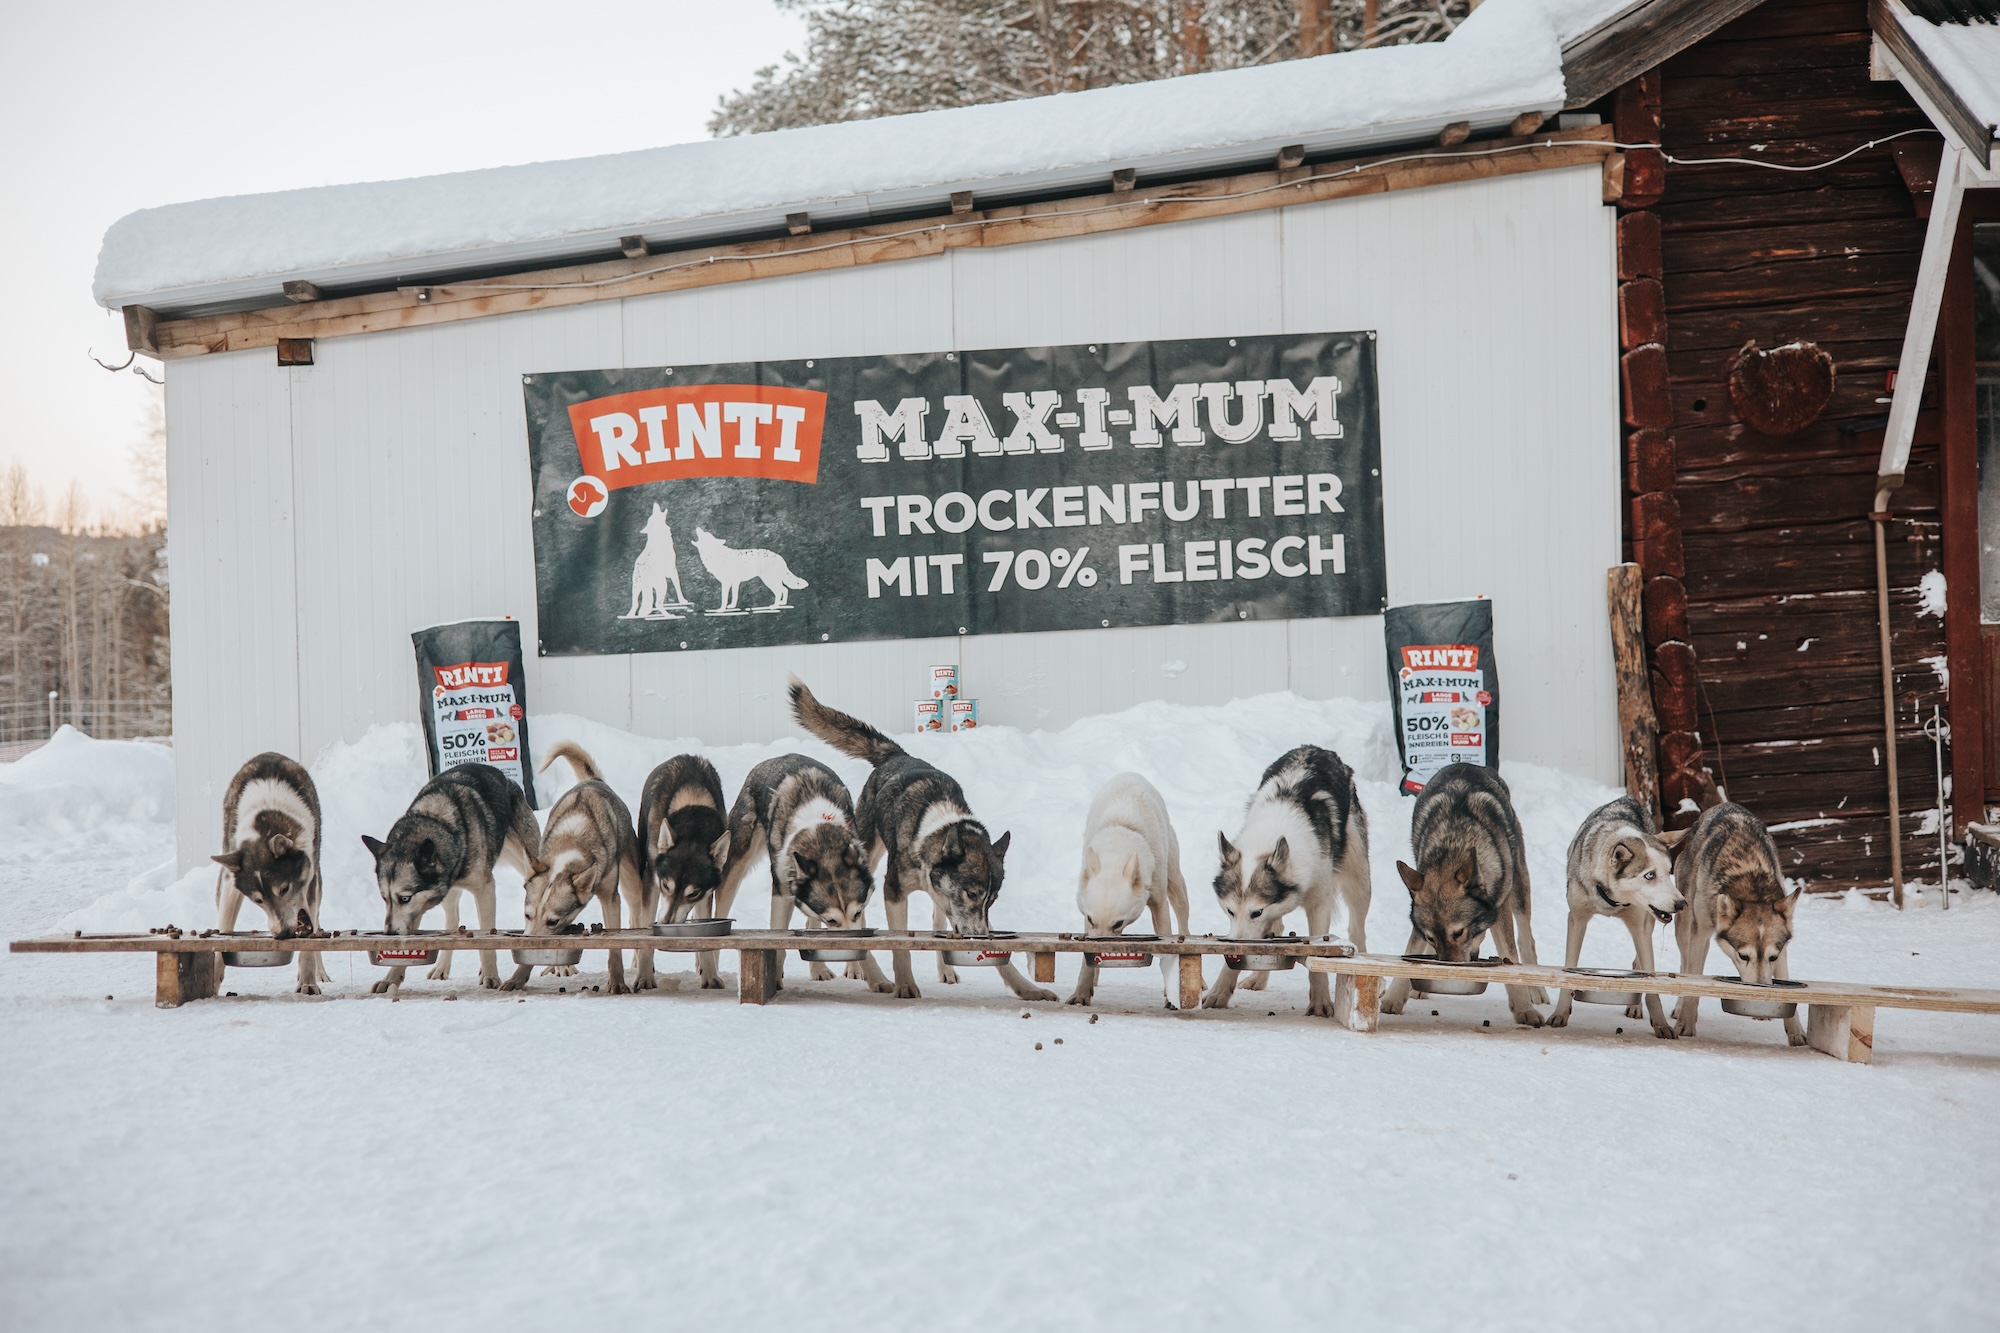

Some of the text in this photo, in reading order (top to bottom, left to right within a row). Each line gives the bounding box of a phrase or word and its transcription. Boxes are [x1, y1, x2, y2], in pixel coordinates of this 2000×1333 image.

[854, 376, 1343, 463] MAX-I-MUM
[590, 402, 805, 471] RINTI
[860, 473, 1345, 537] TROCKENFUTTER
[865, 534, 1346, 599] MIT 70% FLEISCH
[1408, 649, 1472, 667] RINTI
[439, 666, 502, 686] RINTI
[1403, 678, 1479, 691] MAX-I-MUM
[437, 693, 511, 709] MAX-I-MUM
[1407, 716, 1448, 732] 50%
[442, 732, 486, 750] 50%
[444, 749, 478, 759] FLEISCH
